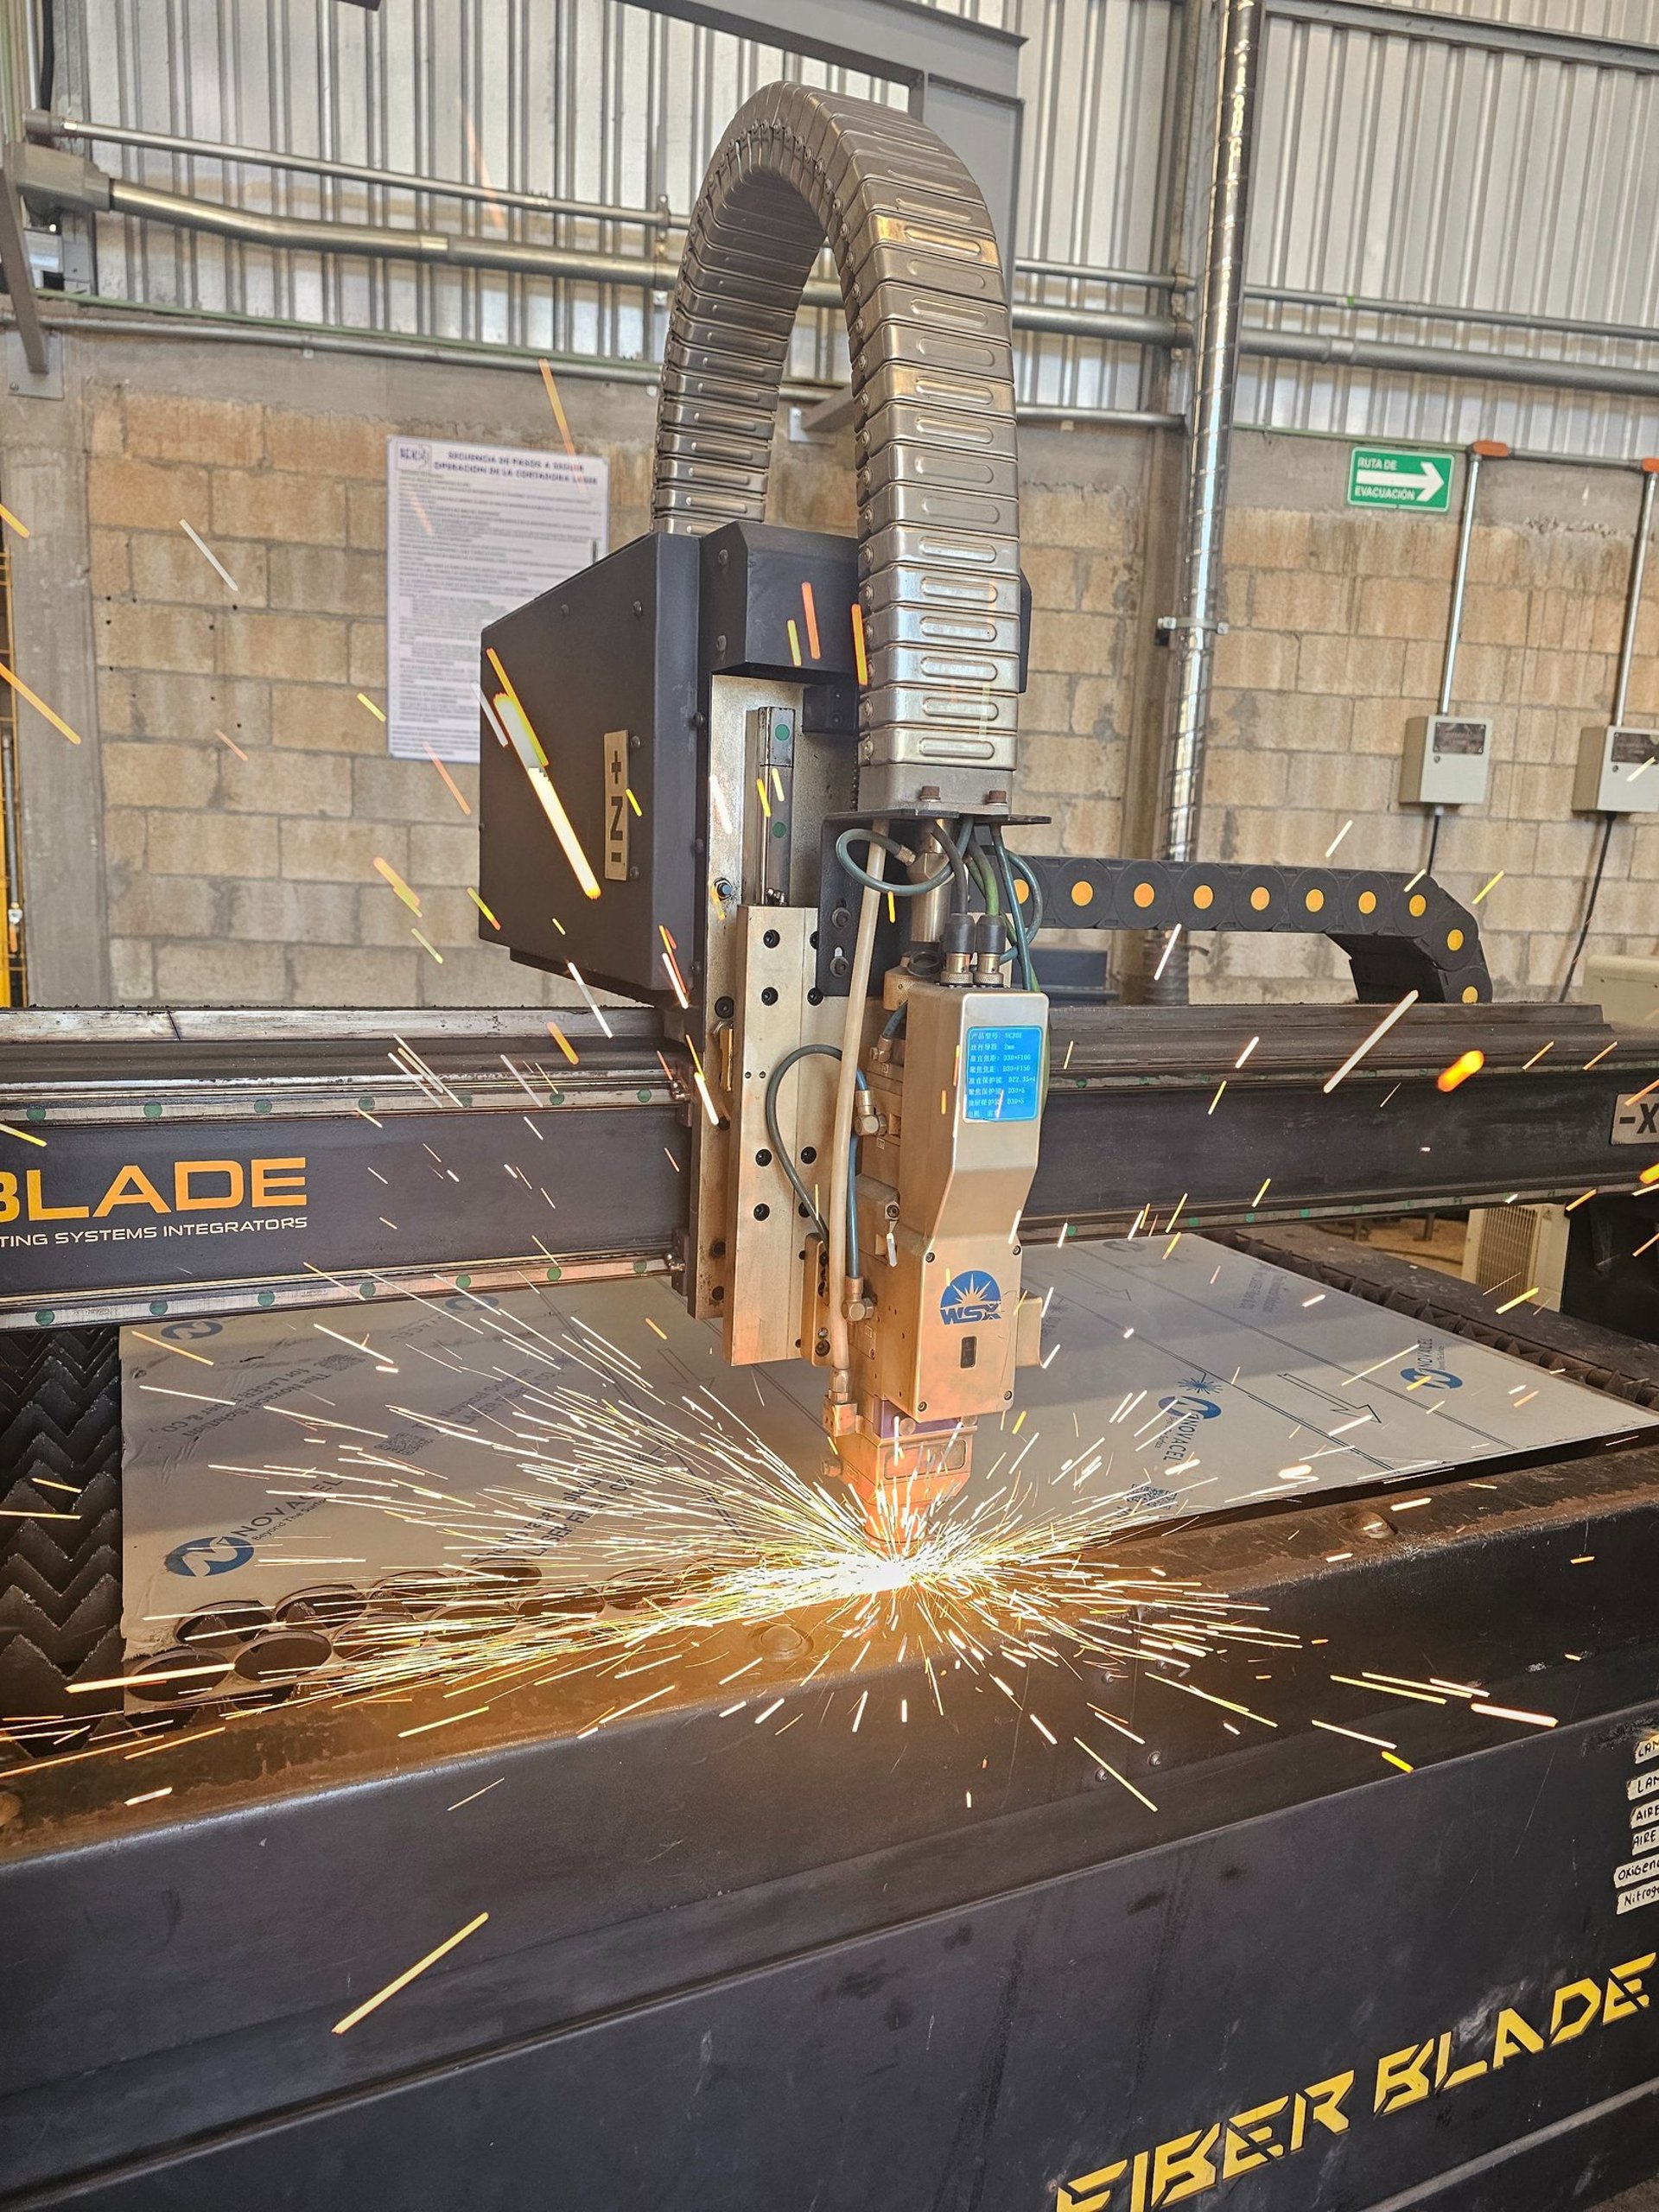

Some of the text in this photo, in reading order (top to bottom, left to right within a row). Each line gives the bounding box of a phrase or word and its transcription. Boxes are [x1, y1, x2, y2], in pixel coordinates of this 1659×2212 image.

[1357, 456, 1397, 471] RUTA DE
[54, 1227, 158, 1245] SYSTEMS
[163, 1217, 308, 1237] INTEGRATORS
[939, 1303, 1001, 1325] WSX
[1633, 1829, 1656, 1847] AIRE
[1056, 1951, 1658, 2212] FIBER BLADE
